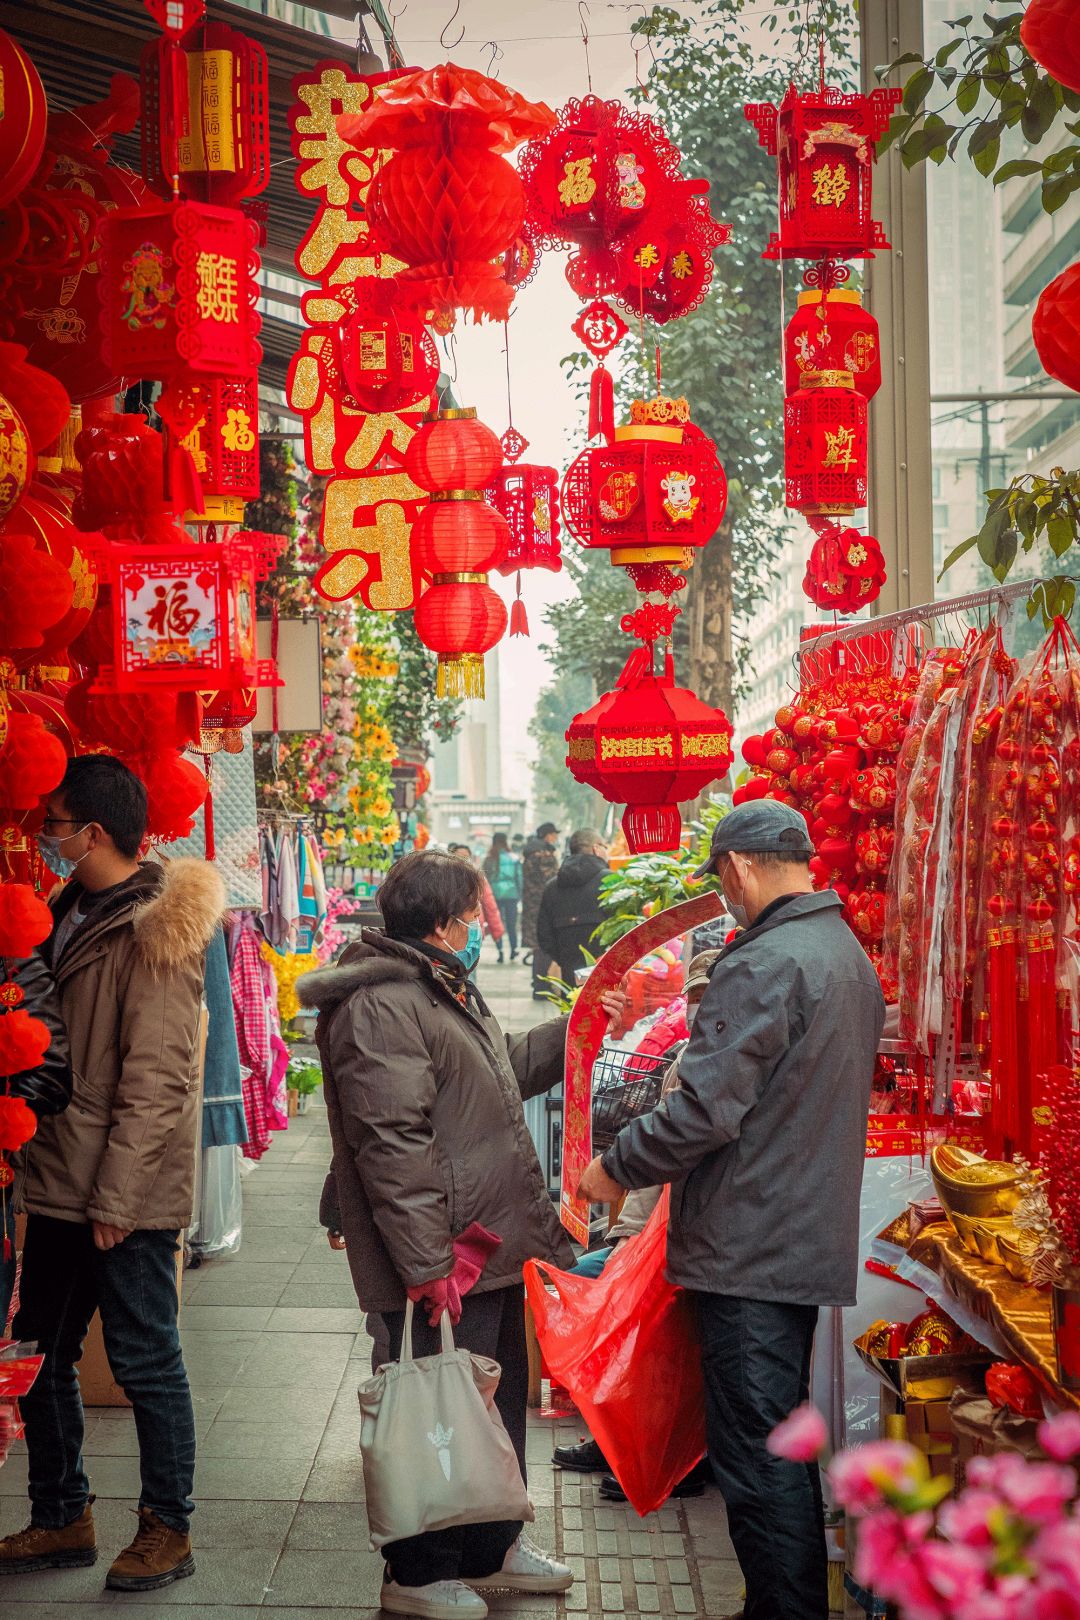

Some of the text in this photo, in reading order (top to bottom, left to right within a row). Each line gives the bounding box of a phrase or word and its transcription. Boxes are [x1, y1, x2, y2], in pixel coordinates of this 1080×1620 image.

[557, 156, 597, 208] 福
[811, 163, 851, 208] 欢度佳节
[633, 243, 660, 269] 春
[671, 250, 694, 280] 春
[144, 580, 201, 645] 福
